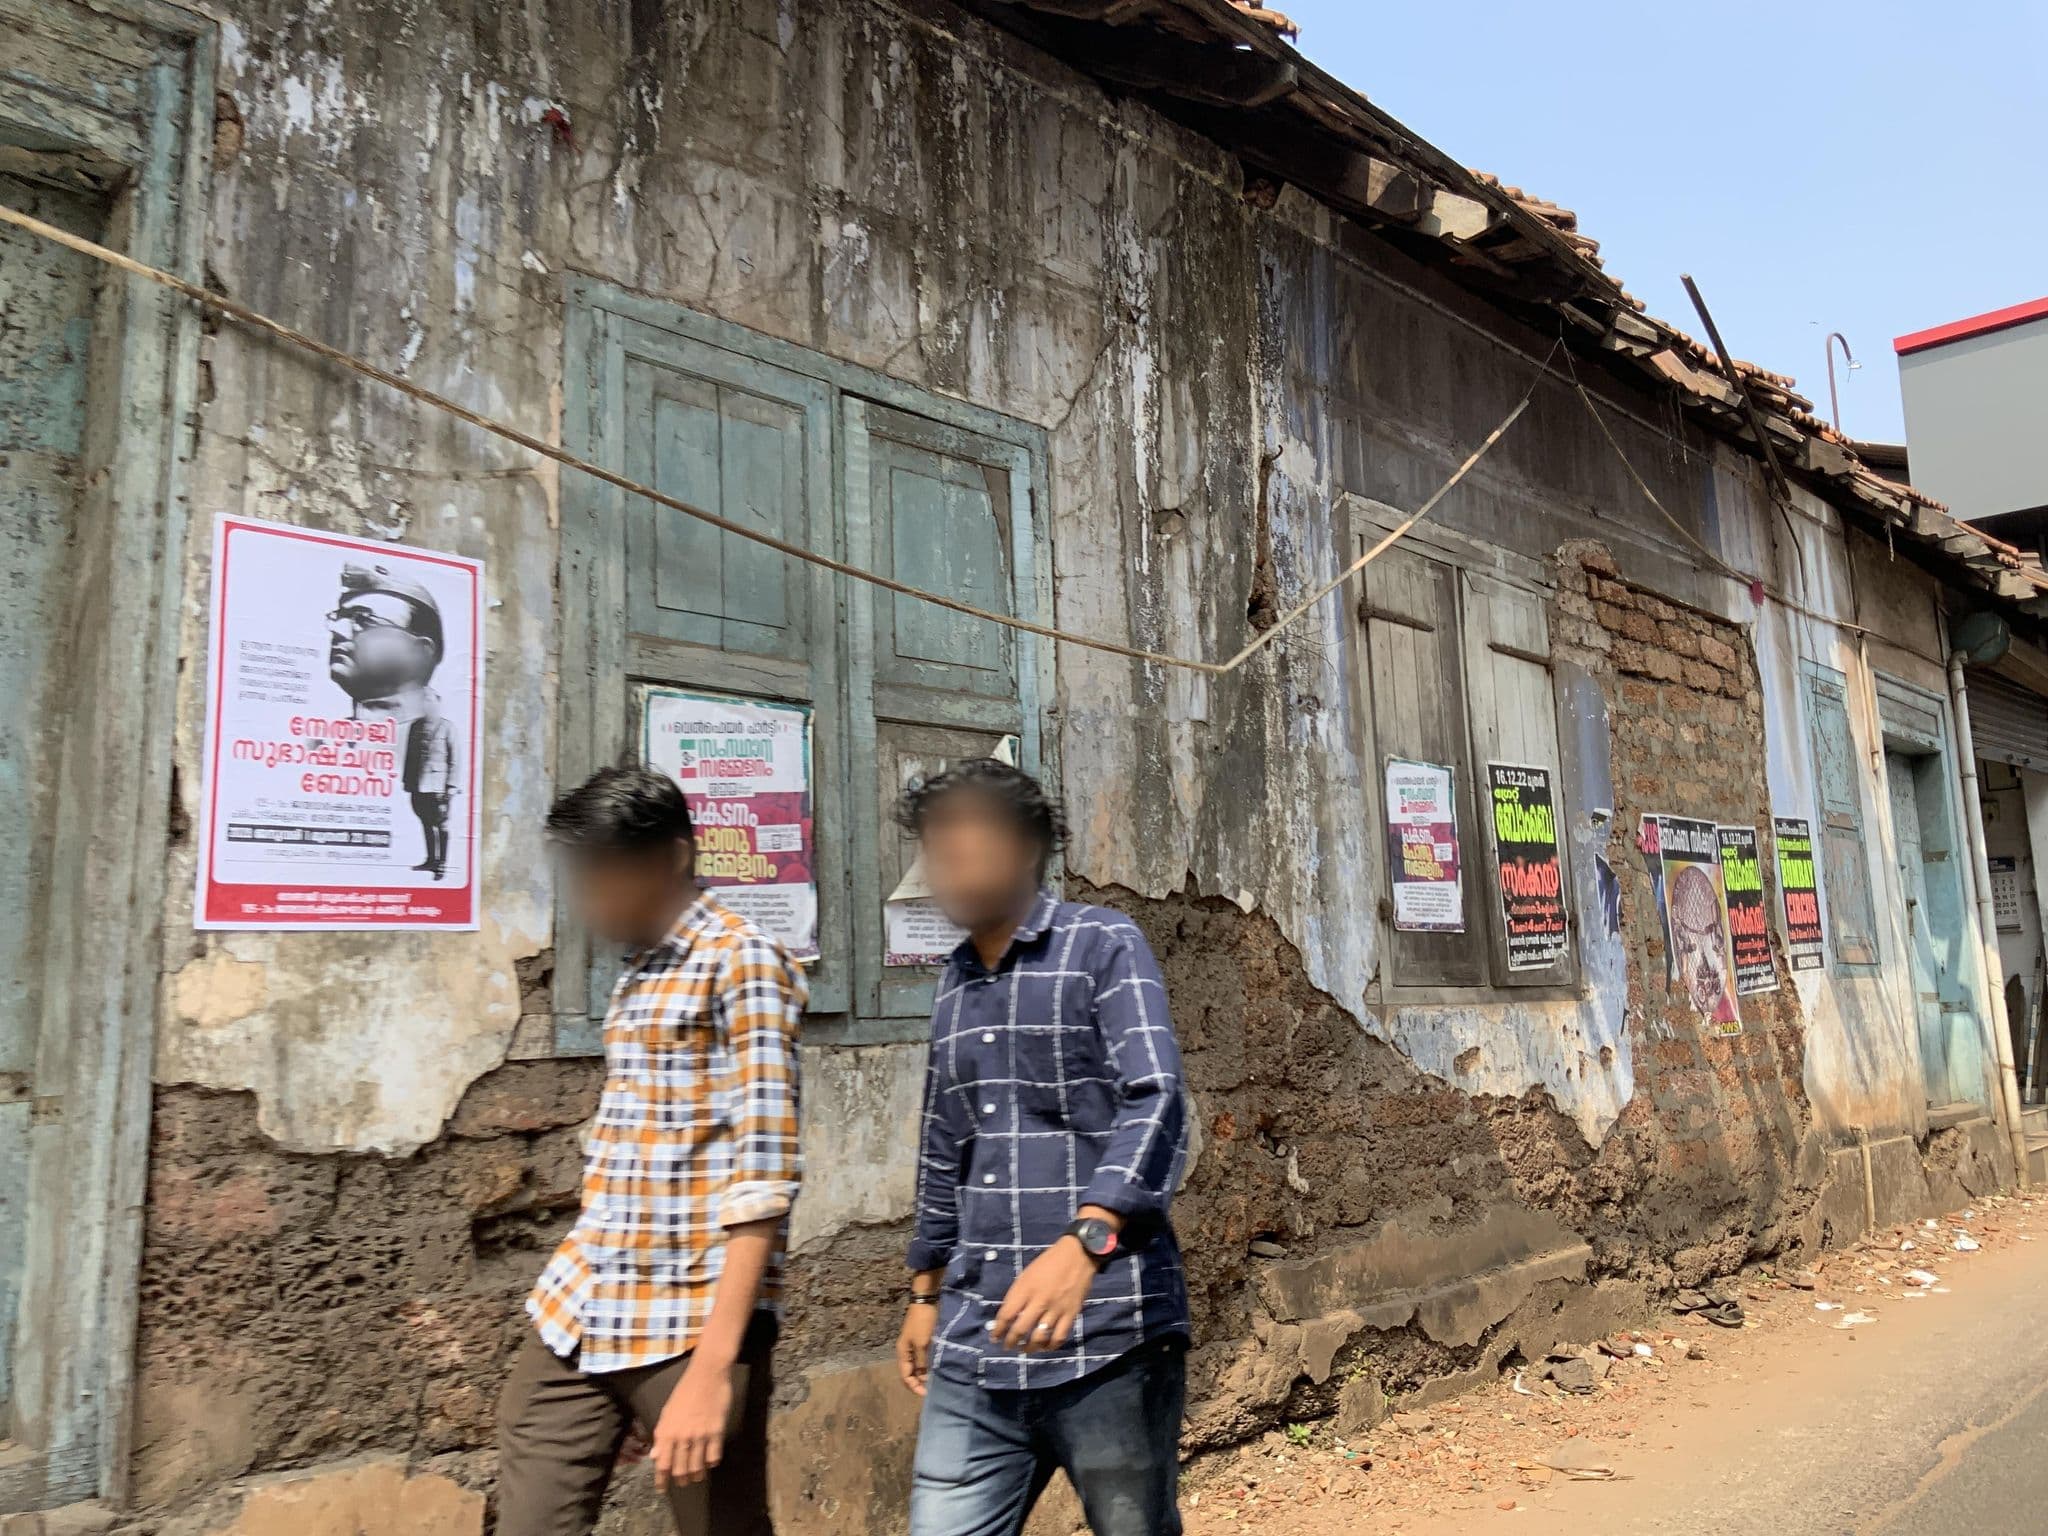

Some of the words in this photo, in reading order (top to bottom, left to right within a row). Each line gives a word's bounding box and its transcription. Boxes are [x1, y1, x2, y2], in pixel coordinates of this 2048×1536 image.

[290, 716, 397, 744] നേതാജി
[301, 772, 398, 797] ബോസ്
[1495, 769, 1527, 786] 16.12.22
[1780, 859, 1815, 888] BOMBAY
[1786, 892, 1818, 925] CIRCUS
[1721, 1021, 1739, 1033] OWS
